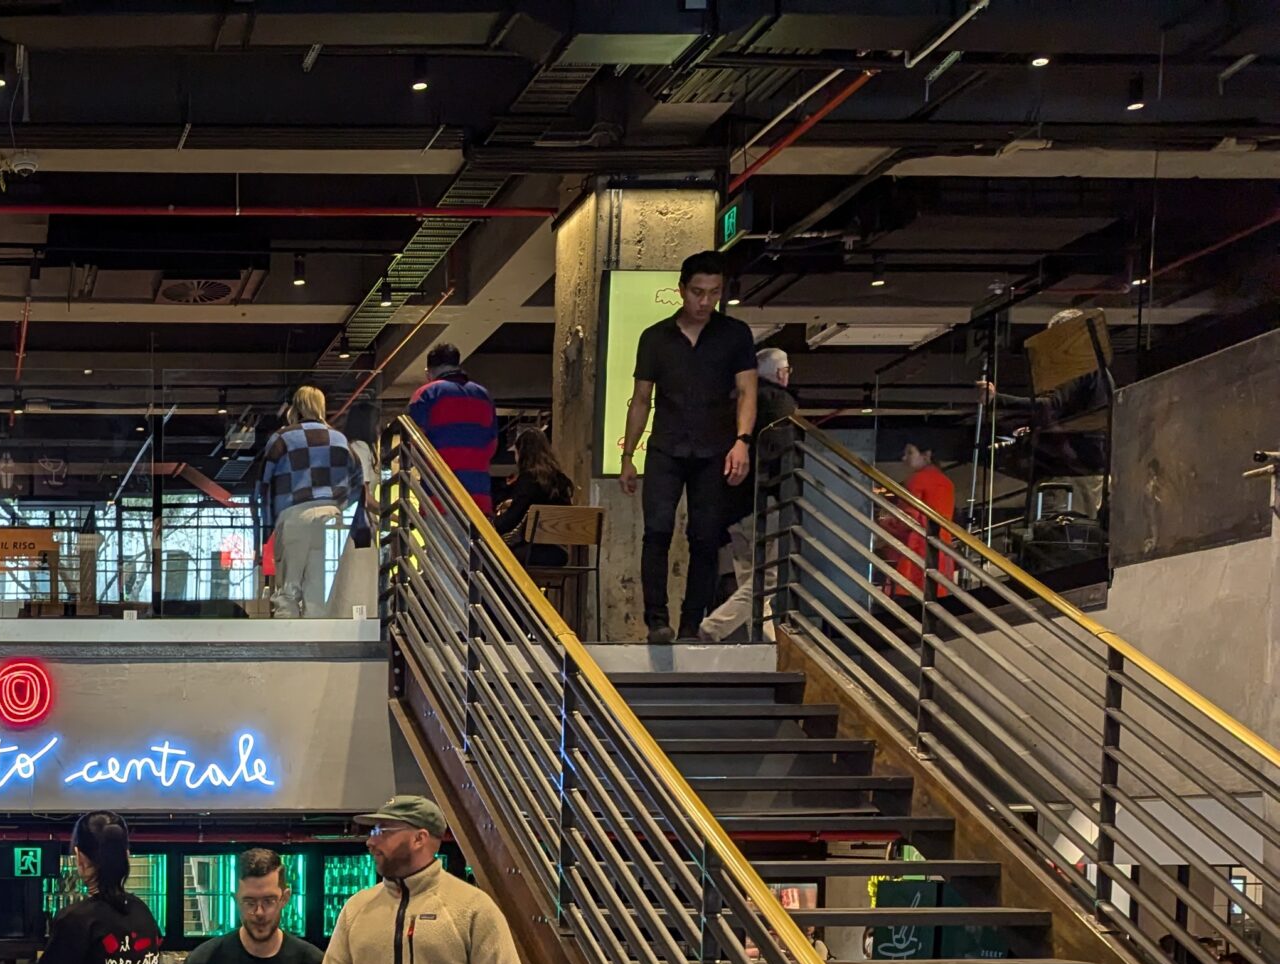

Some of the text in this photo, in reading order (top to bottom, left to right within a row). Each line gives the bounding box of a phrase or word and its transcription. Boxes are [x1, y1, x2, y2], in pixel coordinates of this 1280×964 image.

[0, 541, 35, 550] IL RISO
[64, 732, 275, 789] centrale
[119, 935, 131, 952] il
